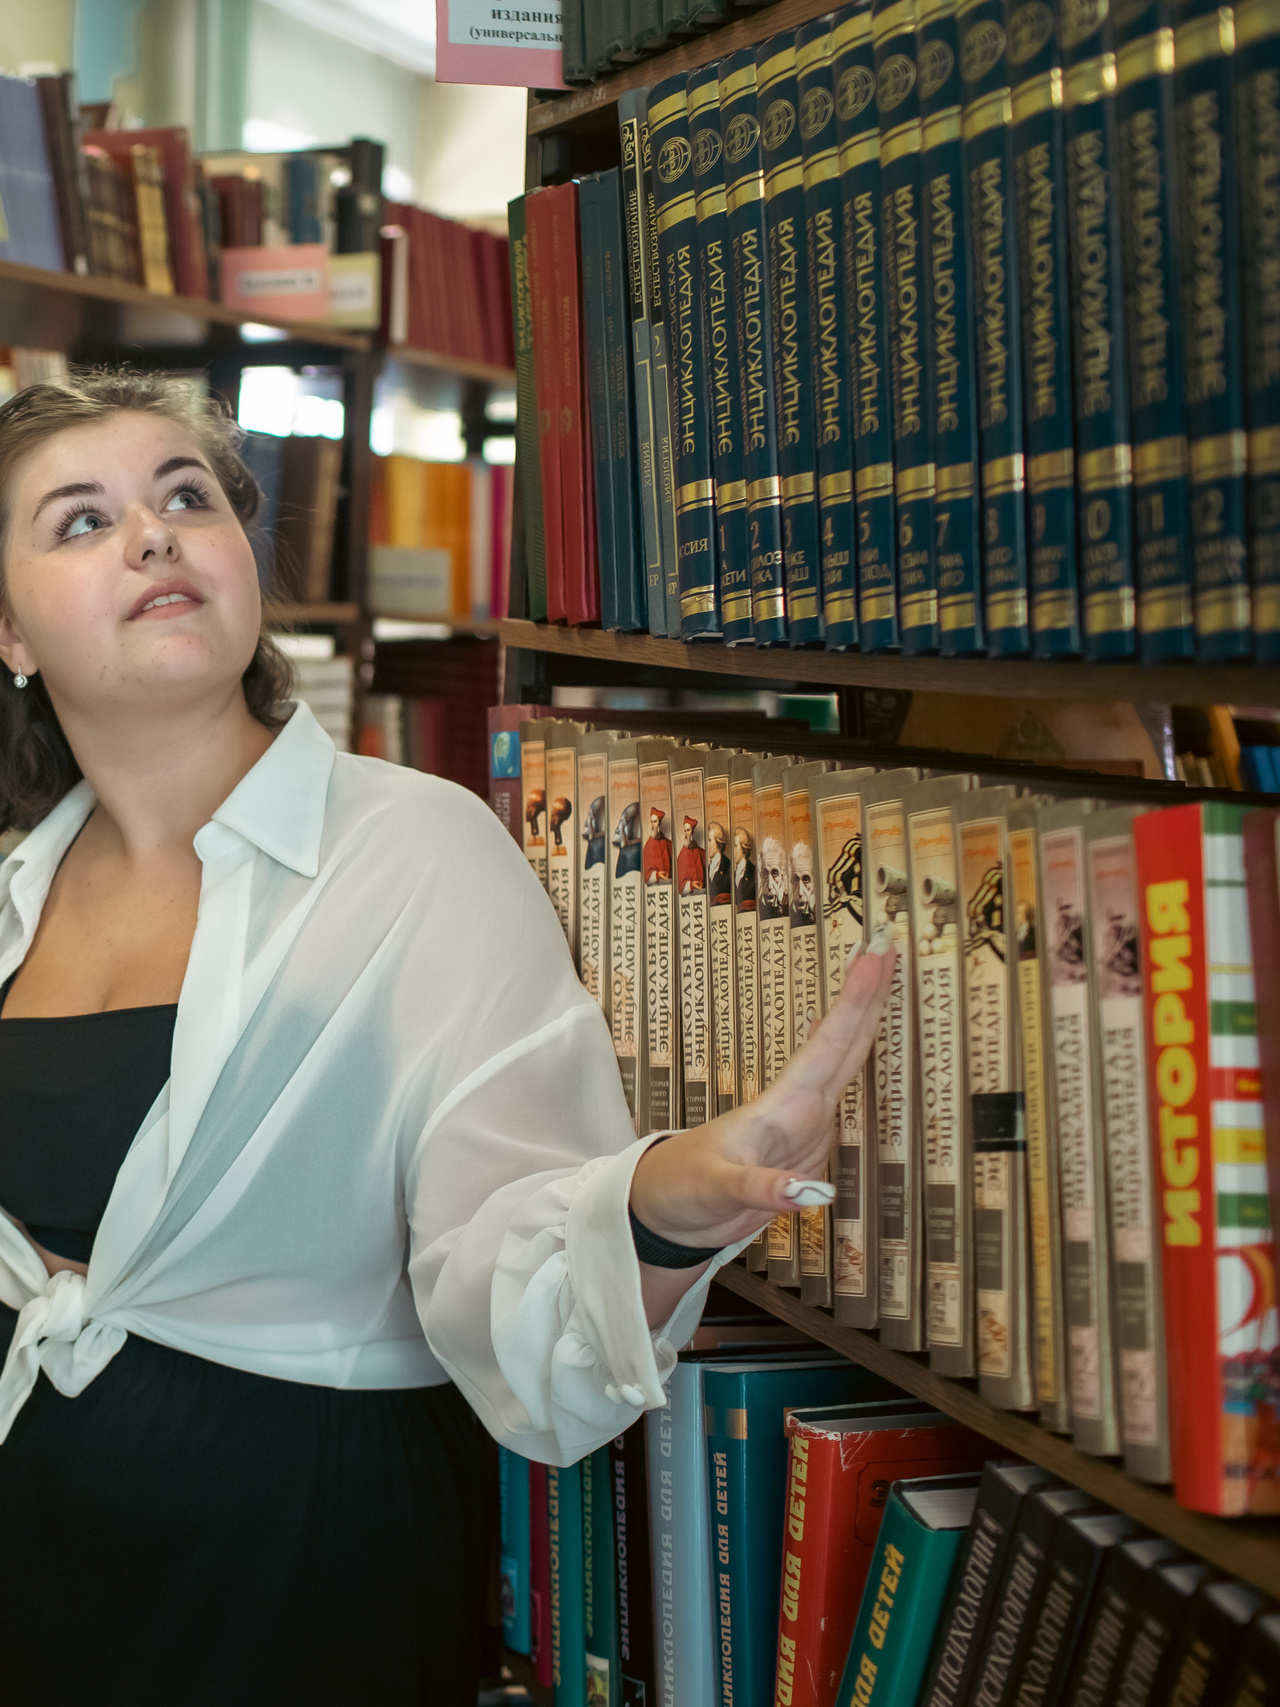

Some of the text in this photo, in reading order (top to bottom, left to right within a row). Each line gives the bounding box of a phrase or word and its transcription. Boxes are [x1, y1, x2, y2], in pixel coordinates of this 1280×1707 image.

[491, 8, 562, 24] издания
[629, 189, 642, 304] ЕСТЕСТВОЗНАНИЕ
[648, 192, 661, 307] ЕСТЕСТВОЗНАНИЕ
[666, 253, 679, 368] РОССИЙСКАЯ
[815, 208, 842, 445] ЭНЦИКЛОПЕДИЯ
[854, 191, 881, 436] ЭНЦИКЛОПЕДИЯ
[894, 184, 923, 437] ЭНЦИКЛОПЕДИЯ
[930, 174, 959, 434] ЭНЦИКЛОПЕДИЯ
[981, 157, 1008, 424] ЭНЦИКЛОПЕДИЯ
[1026, 142, 1057, 420] ЭНЦИКЛОПЕДИЯ
[1074, 130, 1113, 416] ЭНЦИКЛОПЕДИЯ
[677, 245, 697, 455] ЭНЦИКЛОПЕДИЯ
[707, 240, 733, 456] ЭНЦИКЛОПЕДИЯ
[742, 228, 767, 452] ЭНЦИКЛОПЕДИЯ
[778, 217, 802, 447] ЭНЦИКЛОПЕДИЯ
[642, 441, 651, 487] ХИМИЯ
[661, 436, 671, 503] БИОЛОГИЯ
[750, 521, 760, 550] 2
[823, 517, 834, 546] 4
[859, 510, 870, 543] 5
[900, 513, 913, 546] 6
[936, 513, 950, 546] 7
[590, 877, 601, 1002] ЦИКЛОПЕДИЯ
[613, 886, 623, 1042] ШКОЛЬНАЯ
[624, 885, 638, 1044] ЭНЦИКЛОПЕДИЯ
[647, 891, 657, 1053] ШКОЛЬНАЯ
[658, 890, 672, 1054] ЭНЦИКЛОПЕДИЯ
[681, 902, 692, 1067] ШКОЛЬНАЯ
[693, 900, 707, 1068] ЭНЦИКЛОПЕДИЯ
[719, 918, 733, 1072] ЭНЦИКЛОПЕДИЯ
[744, 926, 757, 1082] ЭНЦИКЛОПЕДИЯ
[773, 925, 788, 1078] ЦИКЛОПЕДИЯ
[805, 933, 817, 1023] ОПЕДИЯ
[922, 969, 937, 1166] ШКОЛЬНАЯ
[937, 966, 957, 1167] ЭНЦИКЛОПЕДИЯ
[1145, 878, 1202, 1247] ИСТОРИЯ
[615, 1460, 630, 1661] ЭНЦИКЛОПЕДИЯ
[660, 1469, 673, 1521] ДЛЯ
[788, 1433, 809, 1541] ДЕТЕЙ
[661, 1533, 674, 1707] ЦИКЛОПЕДИЯ
[713, 1452, 734, 1707] ЦИКЛОПЕДИЯ ДЛЯ ДЕТЕЙ
[782, 1550, 801, 1622] ДЛЯ
[868, 1543, 905, 1649] ДЕТЕЙ
[938, 1529, 997, 1695] ПСИХОЛОГИИ
